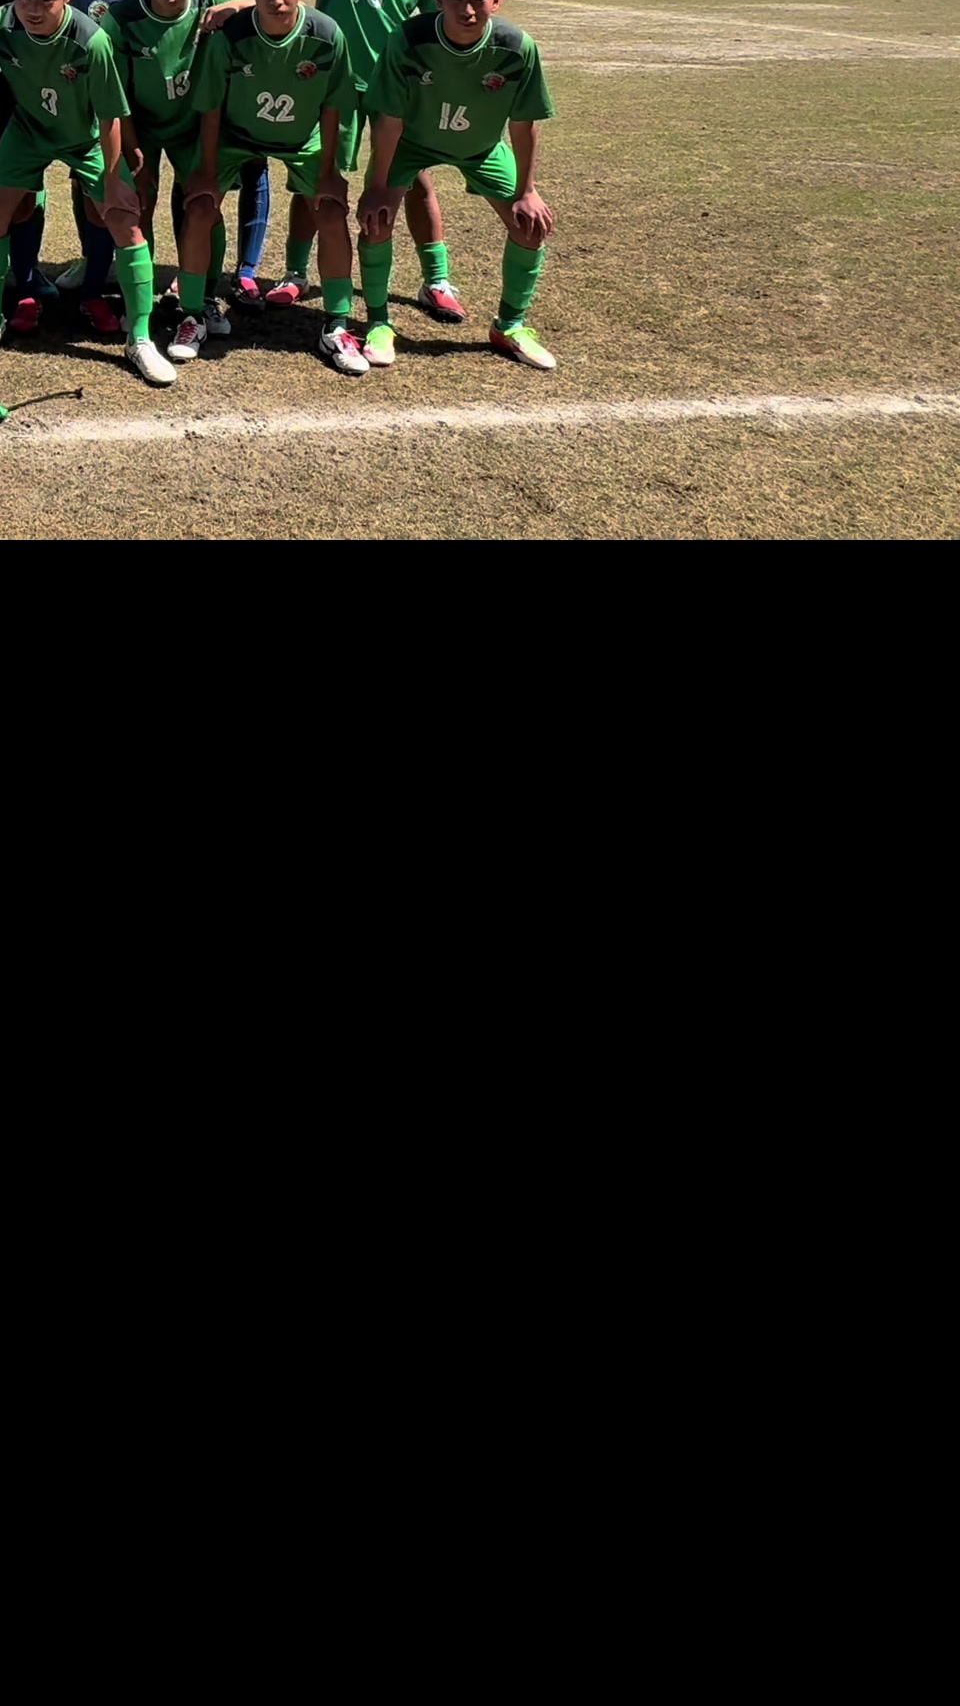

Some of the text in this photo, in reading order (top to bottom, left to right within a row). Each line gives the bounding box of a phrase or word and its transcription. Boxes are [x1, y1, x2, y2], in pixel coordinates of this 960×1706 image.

[165, 70, 191, 100] 13
[256, 91, 295, 122] 22
[439, 101, 471, 131] 16
